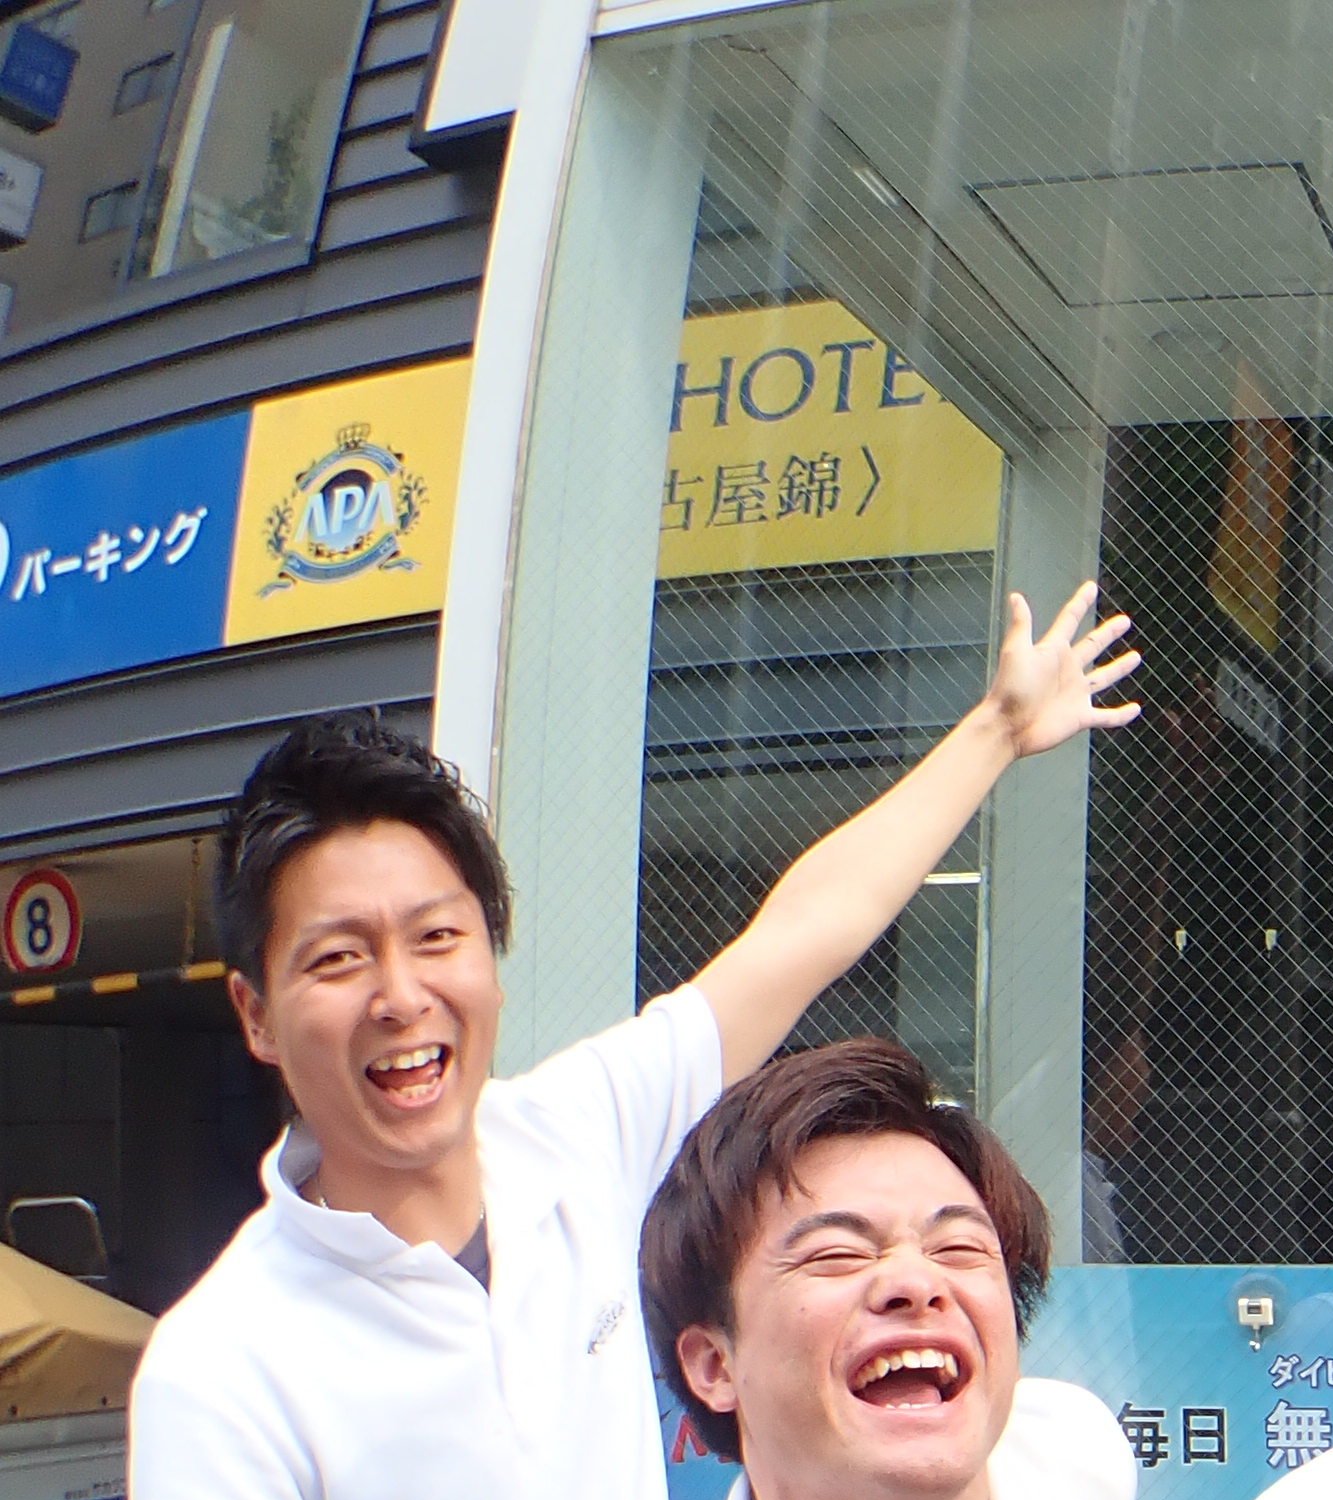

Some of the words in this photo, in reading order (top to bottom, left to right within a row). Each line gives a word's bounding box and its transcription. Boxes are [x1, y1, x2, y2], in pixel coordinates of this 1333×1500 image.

[669, 339, 952, 432] HOTE
[294, 480, 396, 544] APA
[11, 506, 208, 601] パーキング
[1117, 1401, 1227, 1468] 毎日
